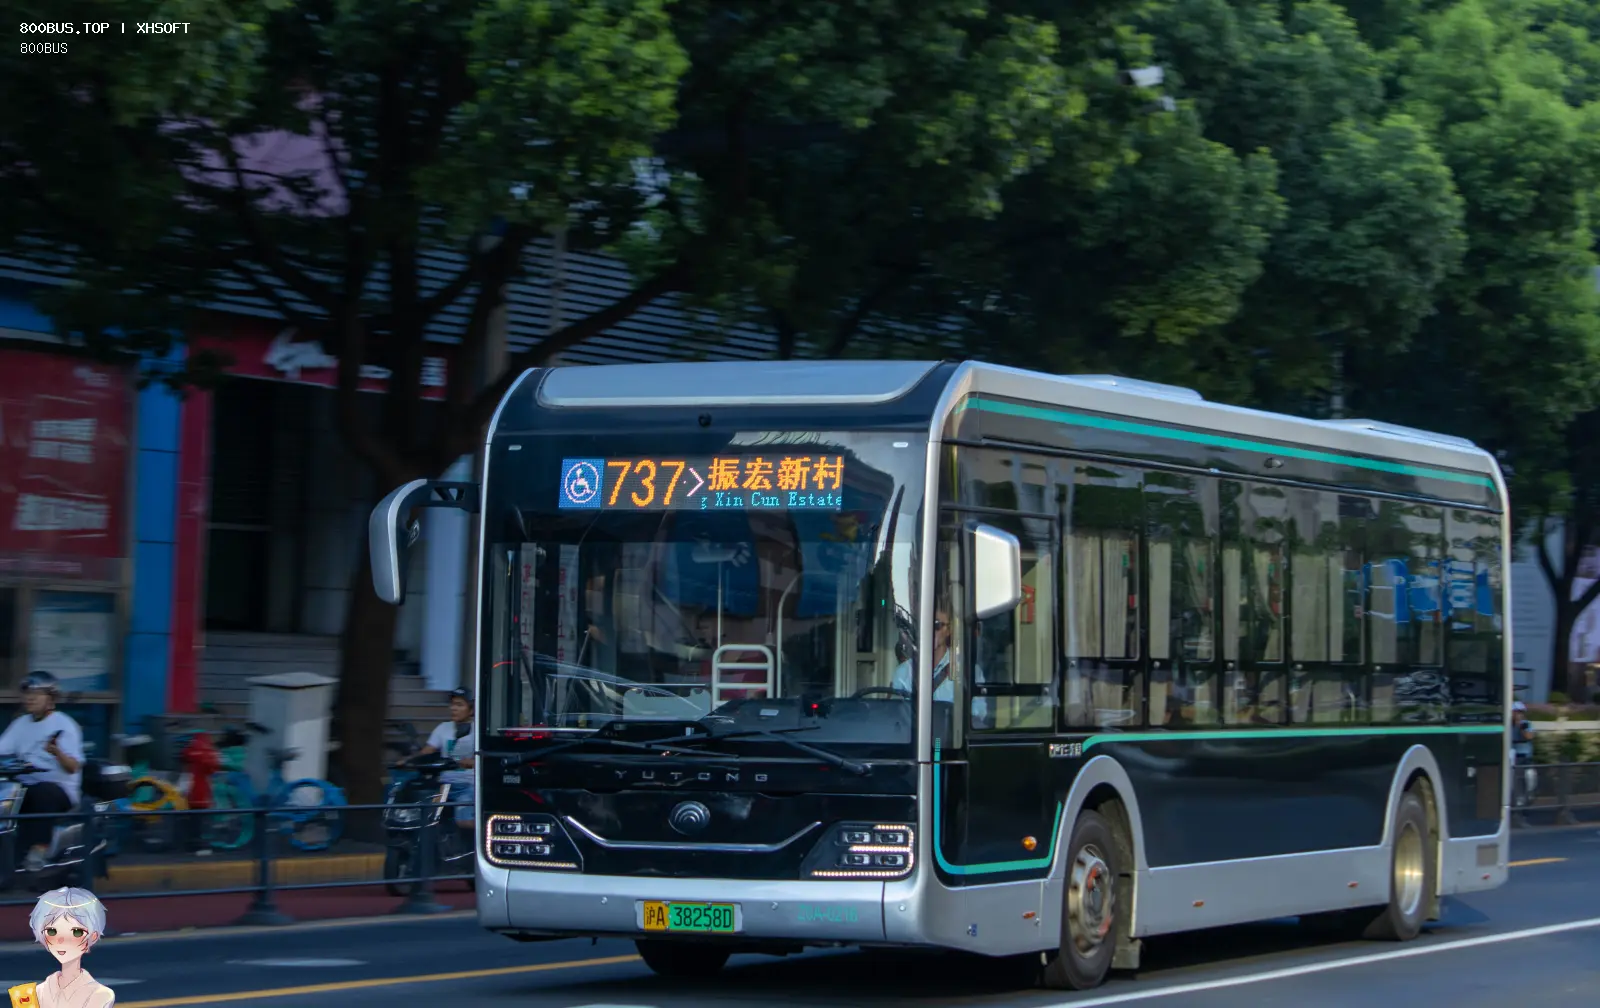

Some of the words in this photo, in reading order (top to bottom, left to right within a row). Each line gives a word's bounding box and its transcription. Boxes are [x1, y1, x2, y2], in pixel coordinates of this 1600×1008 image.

[607, 460, 685, 507] 737
[707, 456, 845, 491] 振宏新村
[715, 491, 744, 507] Xin
[751, 491, 780, 507] Cun
[787, 491, 842, 507] Estate
[615, 770, 768, 782] YUTONG
